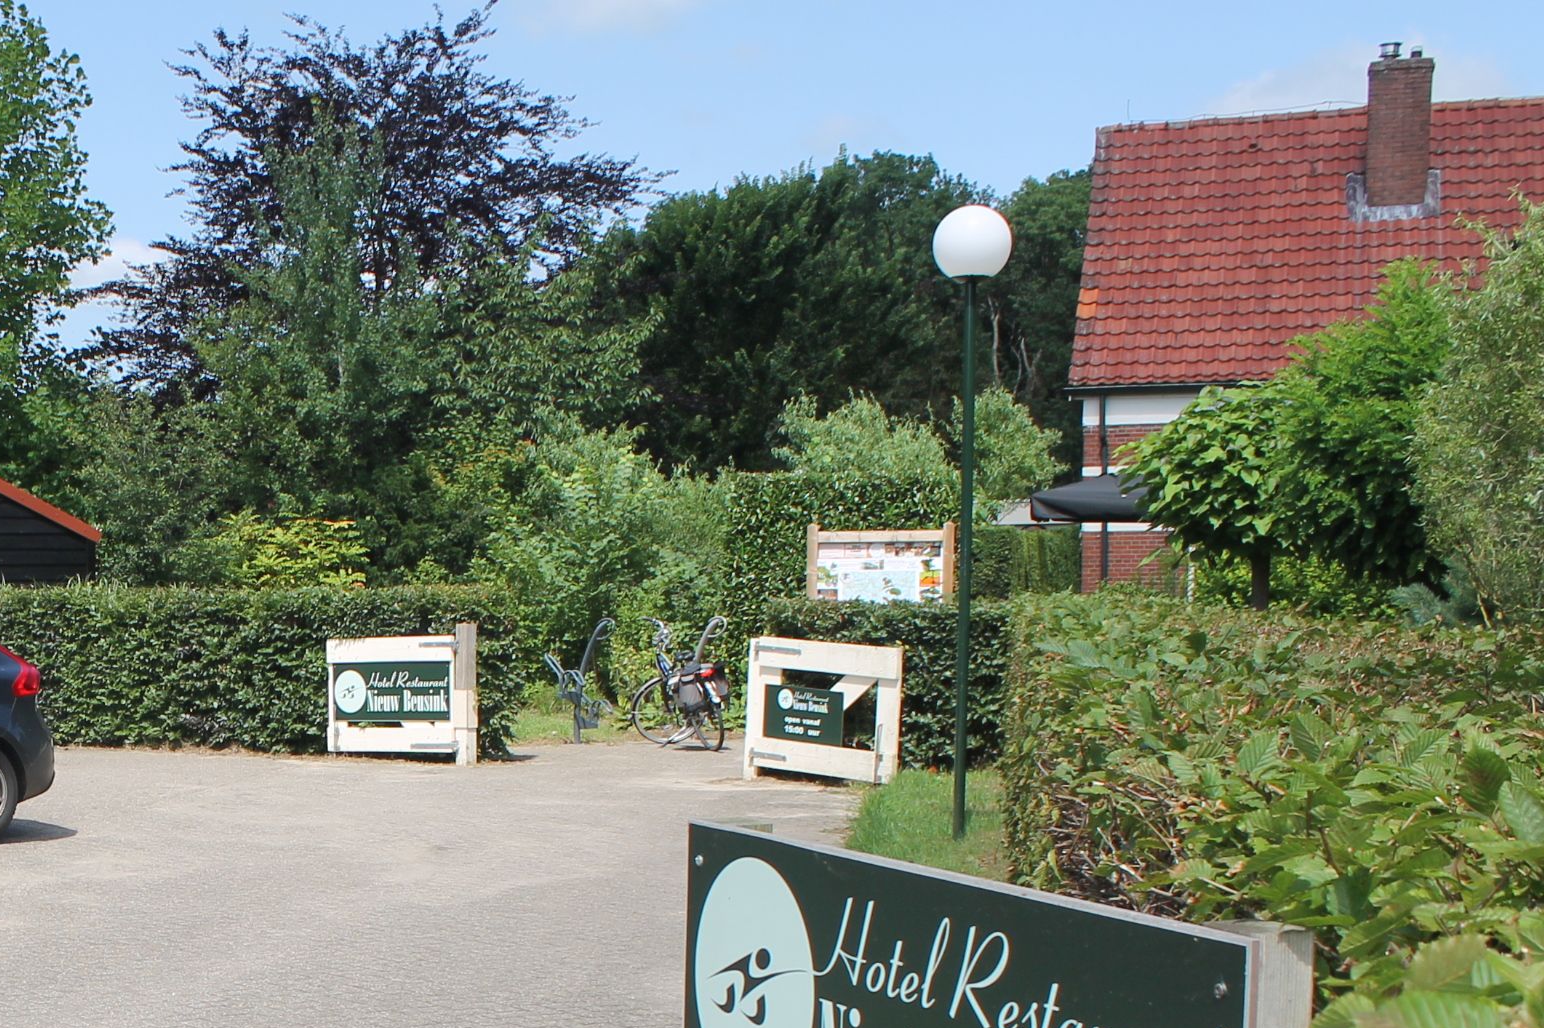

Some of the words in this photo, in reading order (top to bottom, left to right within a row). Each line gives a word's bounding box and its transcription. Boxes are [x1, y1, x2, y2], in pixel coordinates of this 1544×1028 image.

[366, 672, 397, 688] Hotel
[396, 671, 448, 689] Restaurant
[366, 689, 400, 713] Nieuw
[403, 689, 448, 713] Beusink
[813, 896, 951, 1010] Hotel
